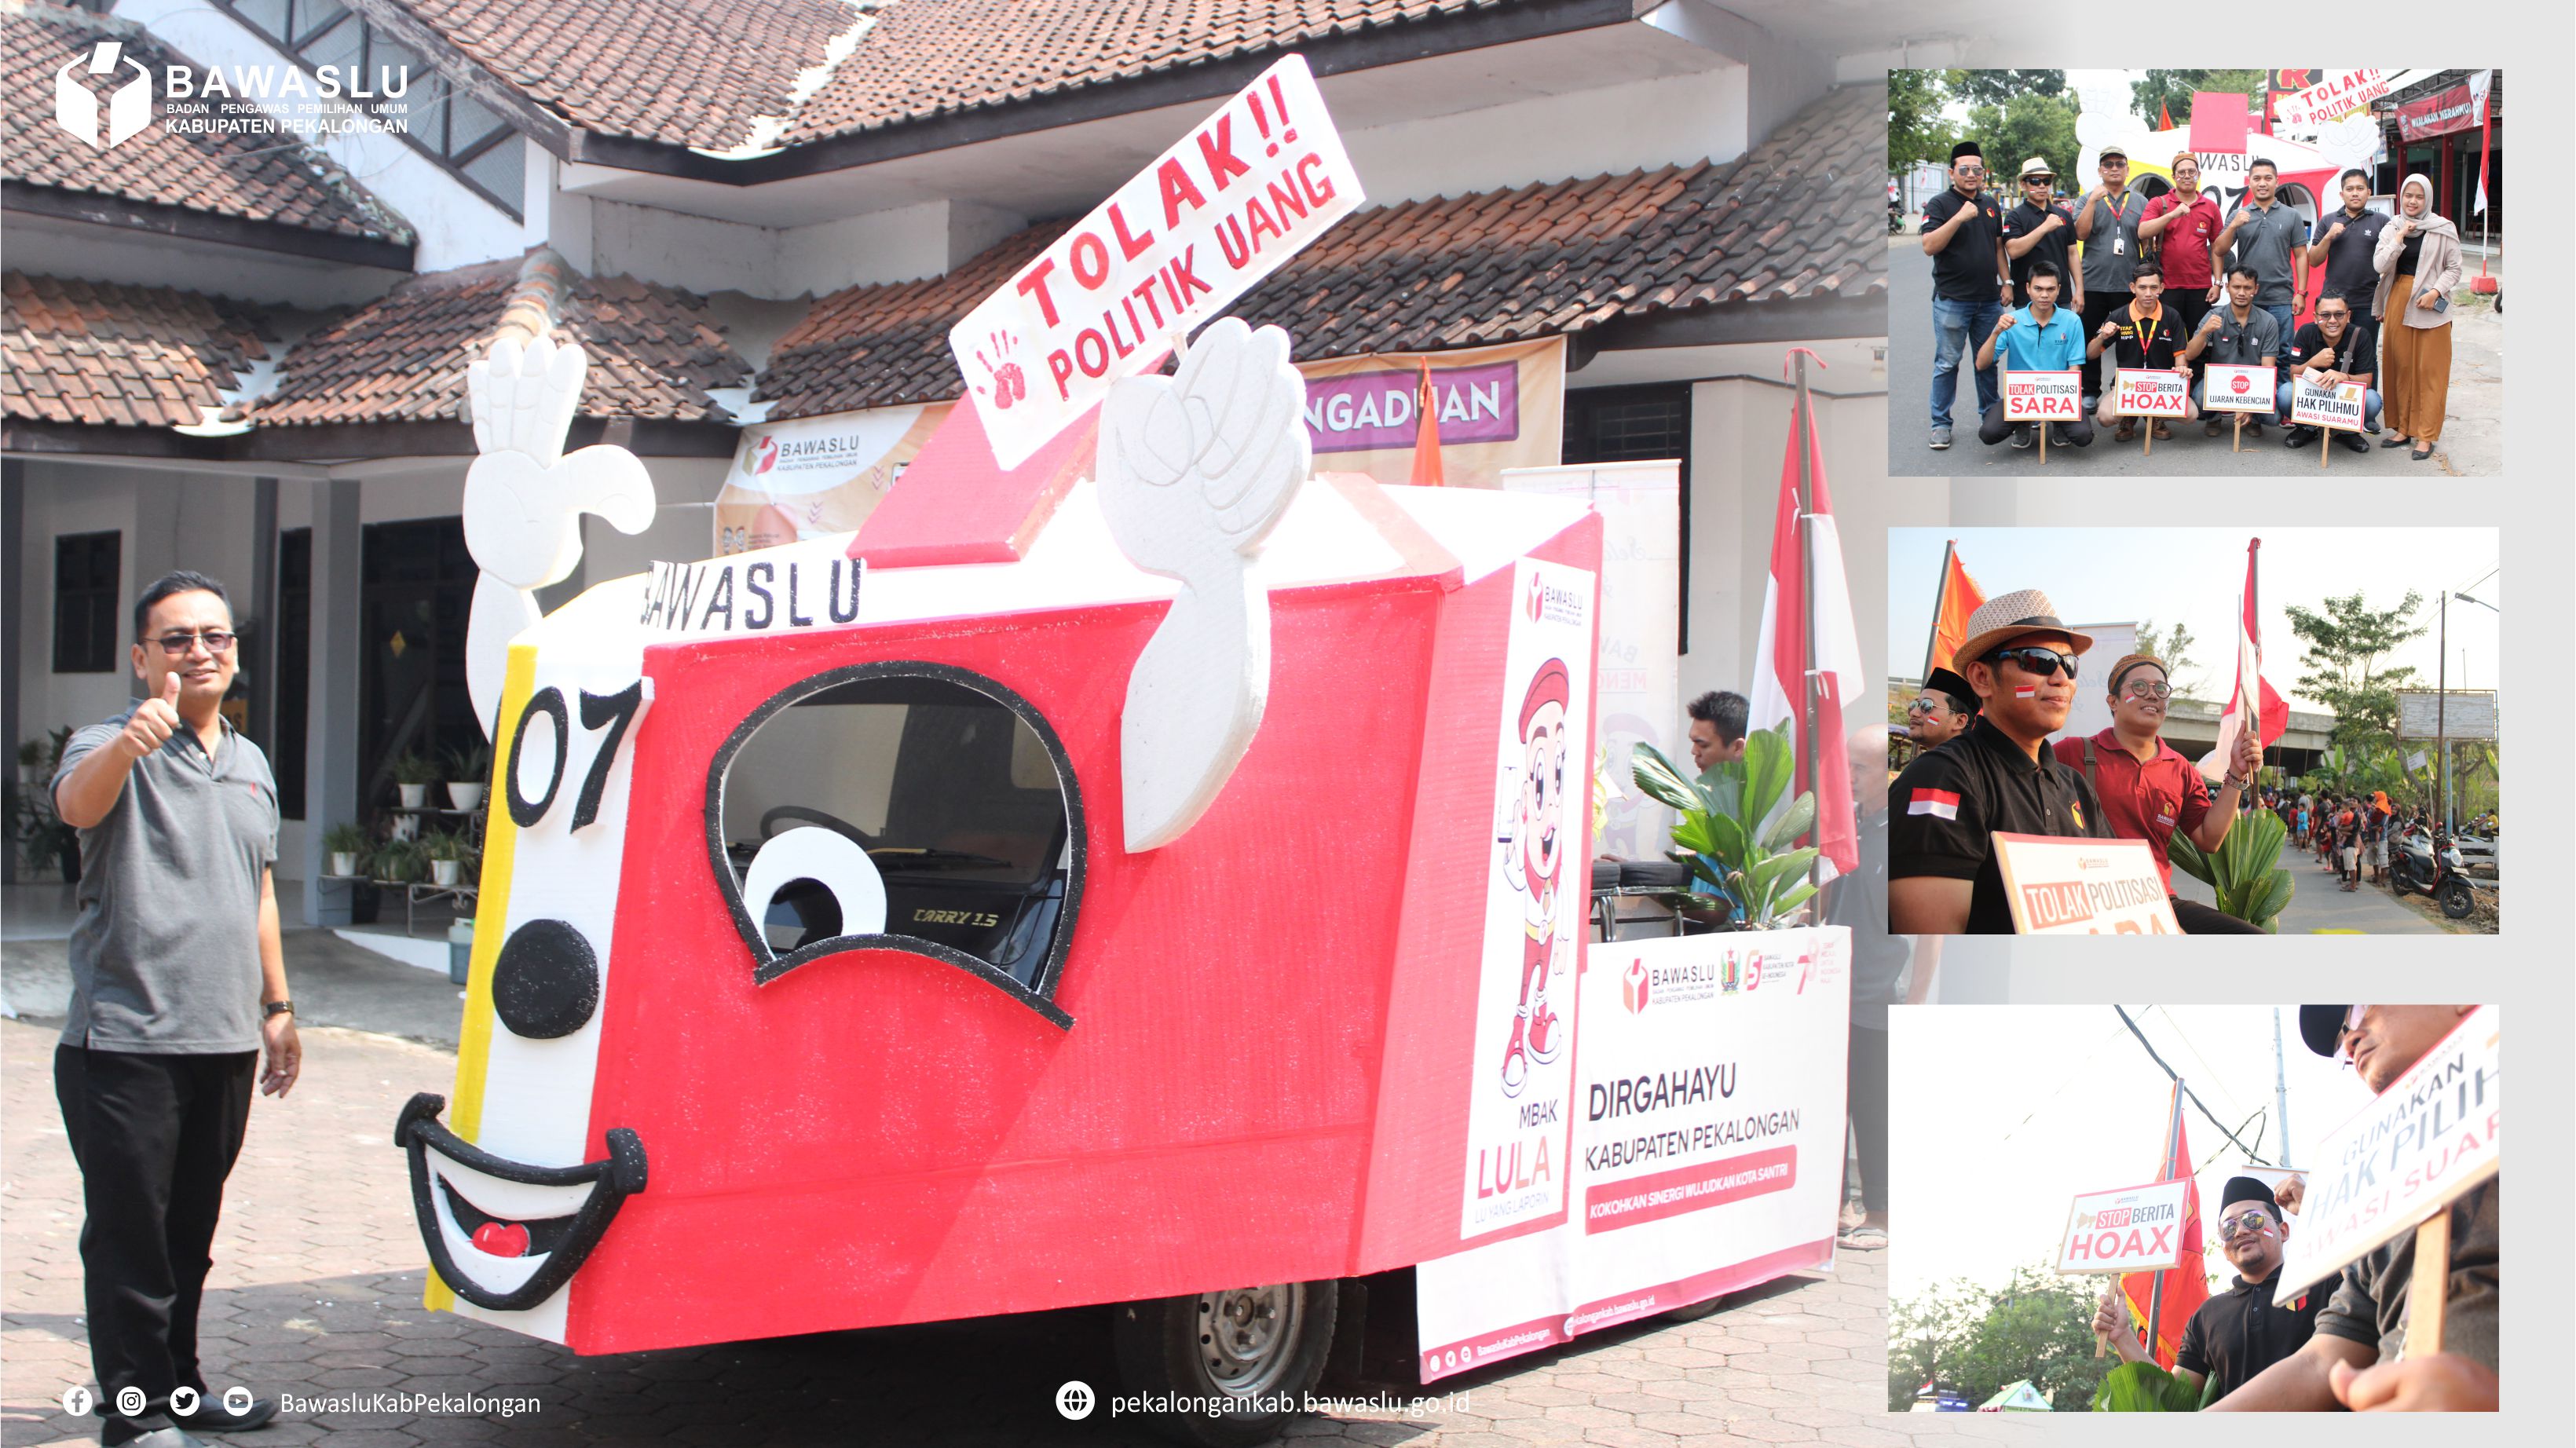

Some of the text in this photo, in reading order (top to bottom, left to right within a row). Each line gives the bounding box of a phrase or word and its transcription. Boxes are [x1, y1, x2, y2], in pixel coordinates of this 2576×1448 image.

[2309, 81, 2390, 125] POLITIK UANG
[1047, 152, 1336, 402] POLITIK UANG
[2009, 384, 2077, 394] TOLAK POLITISASI
[2137, 382, 2183, 393] STOP BERITA
[2232, 380, 2250, 389] STOP
[2305, 388, 2336, 399] GUNAKAN
[2011, 397, 2075, 414] SARA
[2121, 393, 2183, 410] HOAX
[2209, 395, 2270, 405] UJARAN KEBENCIAN
[2296, 397, 2359, 417] HAK PILIHMU
[2296, 411, 2359, 426] AWASI SUARAMU
[781, 435, 859, 457] BAWASLU
[640, 558, 862, 631] BAWASLU
[1546, 587, 1583, 610] BAWASLU
[506, 676, 643, 835] 07
[2026, 884, 2091, 924] TOLAK
[2088, 876, 2163, 912] POLITISASI
[913, 909, 972, 923] CARRY
[1652, 964, 1714, 986] BAWASLU
[1589, 1062, 1736, 1121] DIRGAHAYU
[1519, 1099, 1558, 1129] MBAK
[2343, 1051, 2464, 1166] GUNAKAN
[1585, 1108, 1800, 1172] KABUPATEN PEKALONGAN
[1477, 1135, 1550, 1199] LULA
[1590, 1163, 1788, 1219] KOKOHKAN SINERGI WUJUDKAN KOTA SANTRI
[2308, 1149, 2380, 1228] HAK
[2098, 1203, 2175, 1227] STOP BERITA
[2301, 1190, 2389, 1260] AWASI
[2069, 1224, 2174, 1260] HOAX
